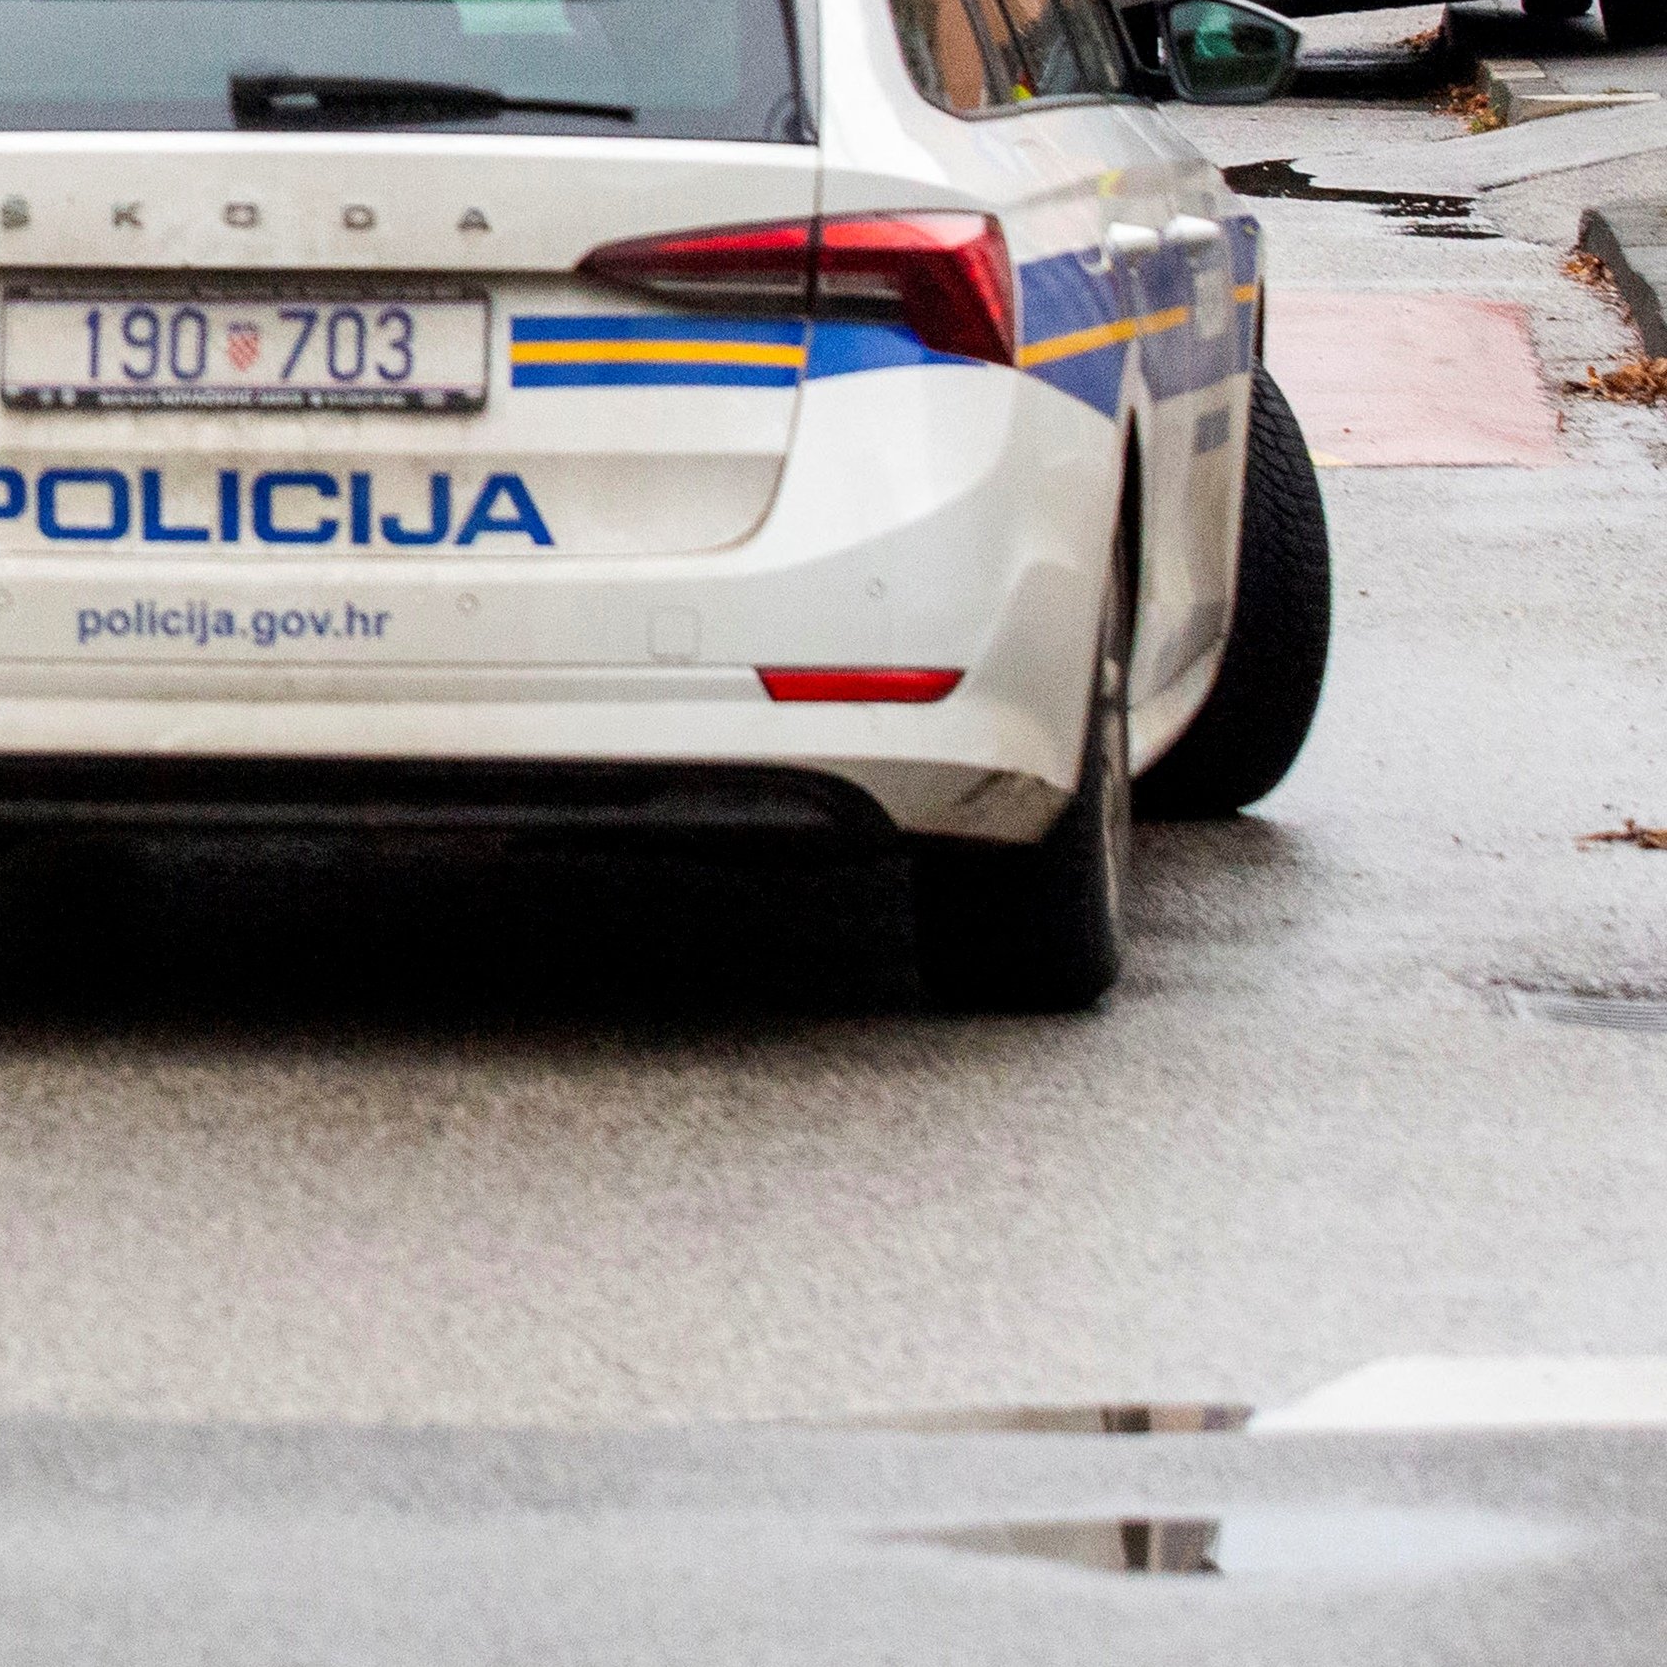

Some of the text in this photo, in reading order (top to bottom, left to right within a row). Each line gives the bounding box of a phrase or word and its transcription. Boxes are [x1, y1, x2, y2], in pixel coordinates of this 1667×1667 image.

[84, 306, 417, 383] 190 703
[78, 599, 391, 646] policija.gov.hr
